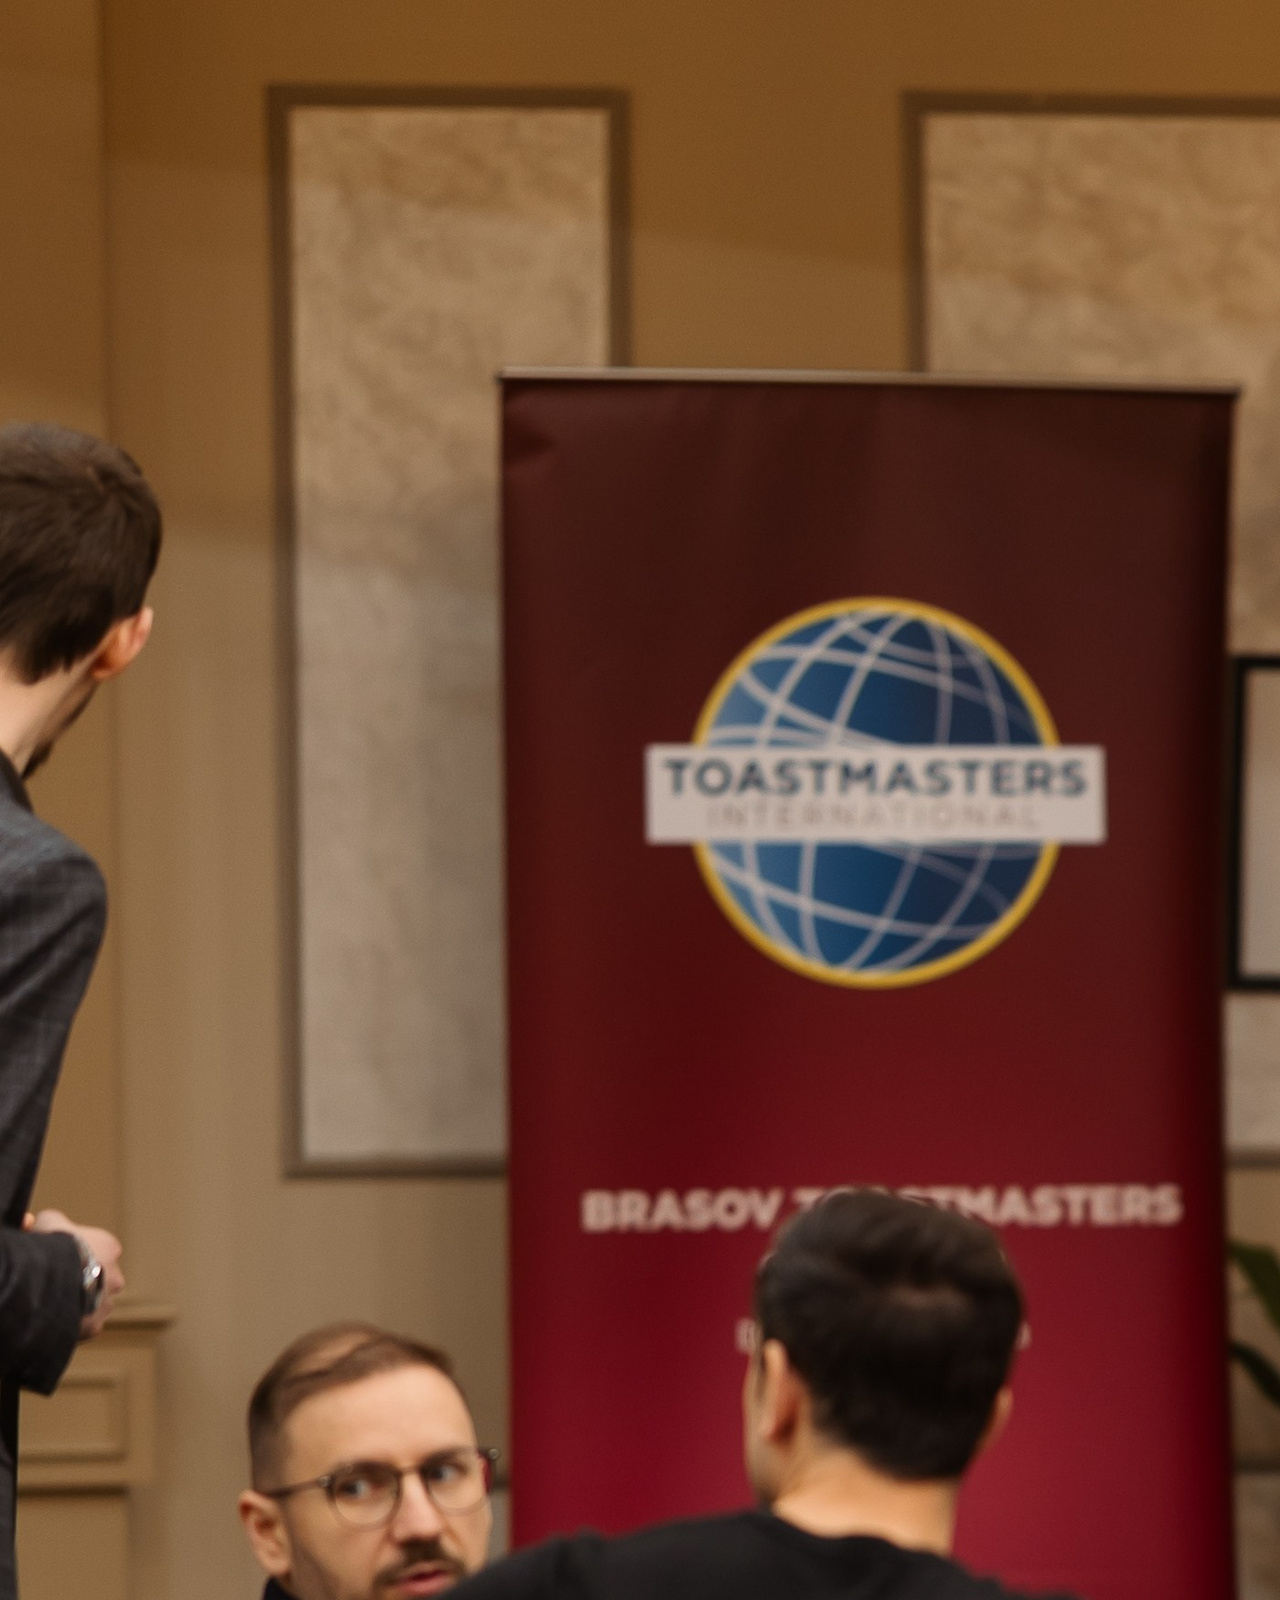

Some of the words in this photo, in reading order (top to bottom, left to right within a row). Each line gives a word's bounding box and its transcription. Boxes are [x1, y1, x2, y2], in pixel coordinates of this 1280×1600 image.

[664, 757, 1087, 796] TOASTMASTERS
[705, 801, 1039, 830] INTERNATIONAL
[582, 1190, 783, 1231] BRASOV
